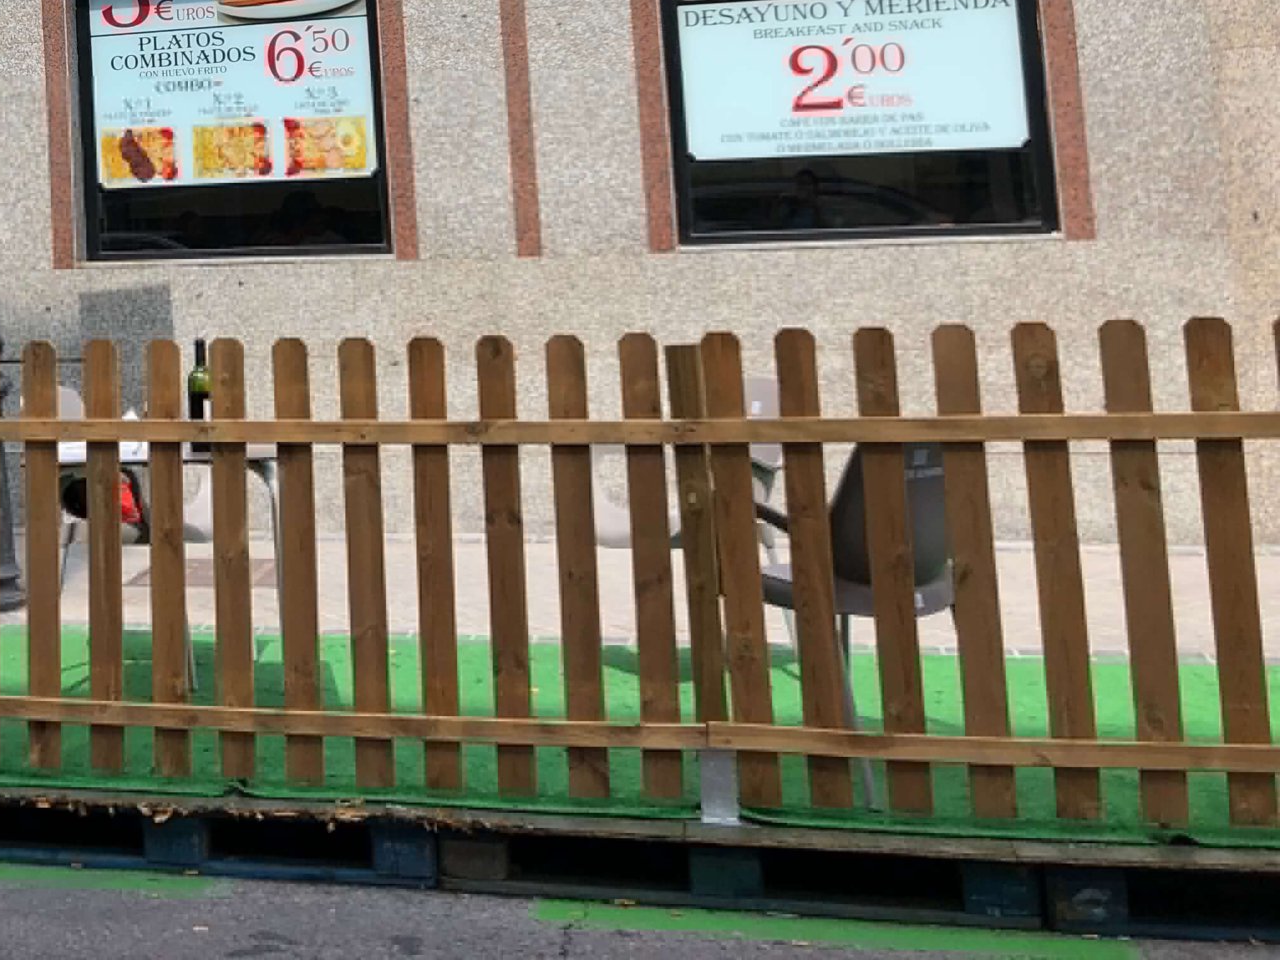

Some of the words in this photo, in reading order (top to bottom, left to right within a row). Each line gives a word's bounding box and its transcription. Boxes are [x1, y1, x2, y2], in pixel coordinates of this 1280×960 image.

[683, 2, 828, 28] DESAYUNO
[753, 23, 847, 40] BREAKFAST
[851, 20, 884, 34] AND
[888, 18, 943, 32] SNACK
[138, 31, 225, 52] PLATOS
[110, 46, 256, 72] COMBINADOS
[139, 71, 159, 79] CON
[161, 67, 195, 77] HUEVO
[197, 65, 227, 75] FRITO
